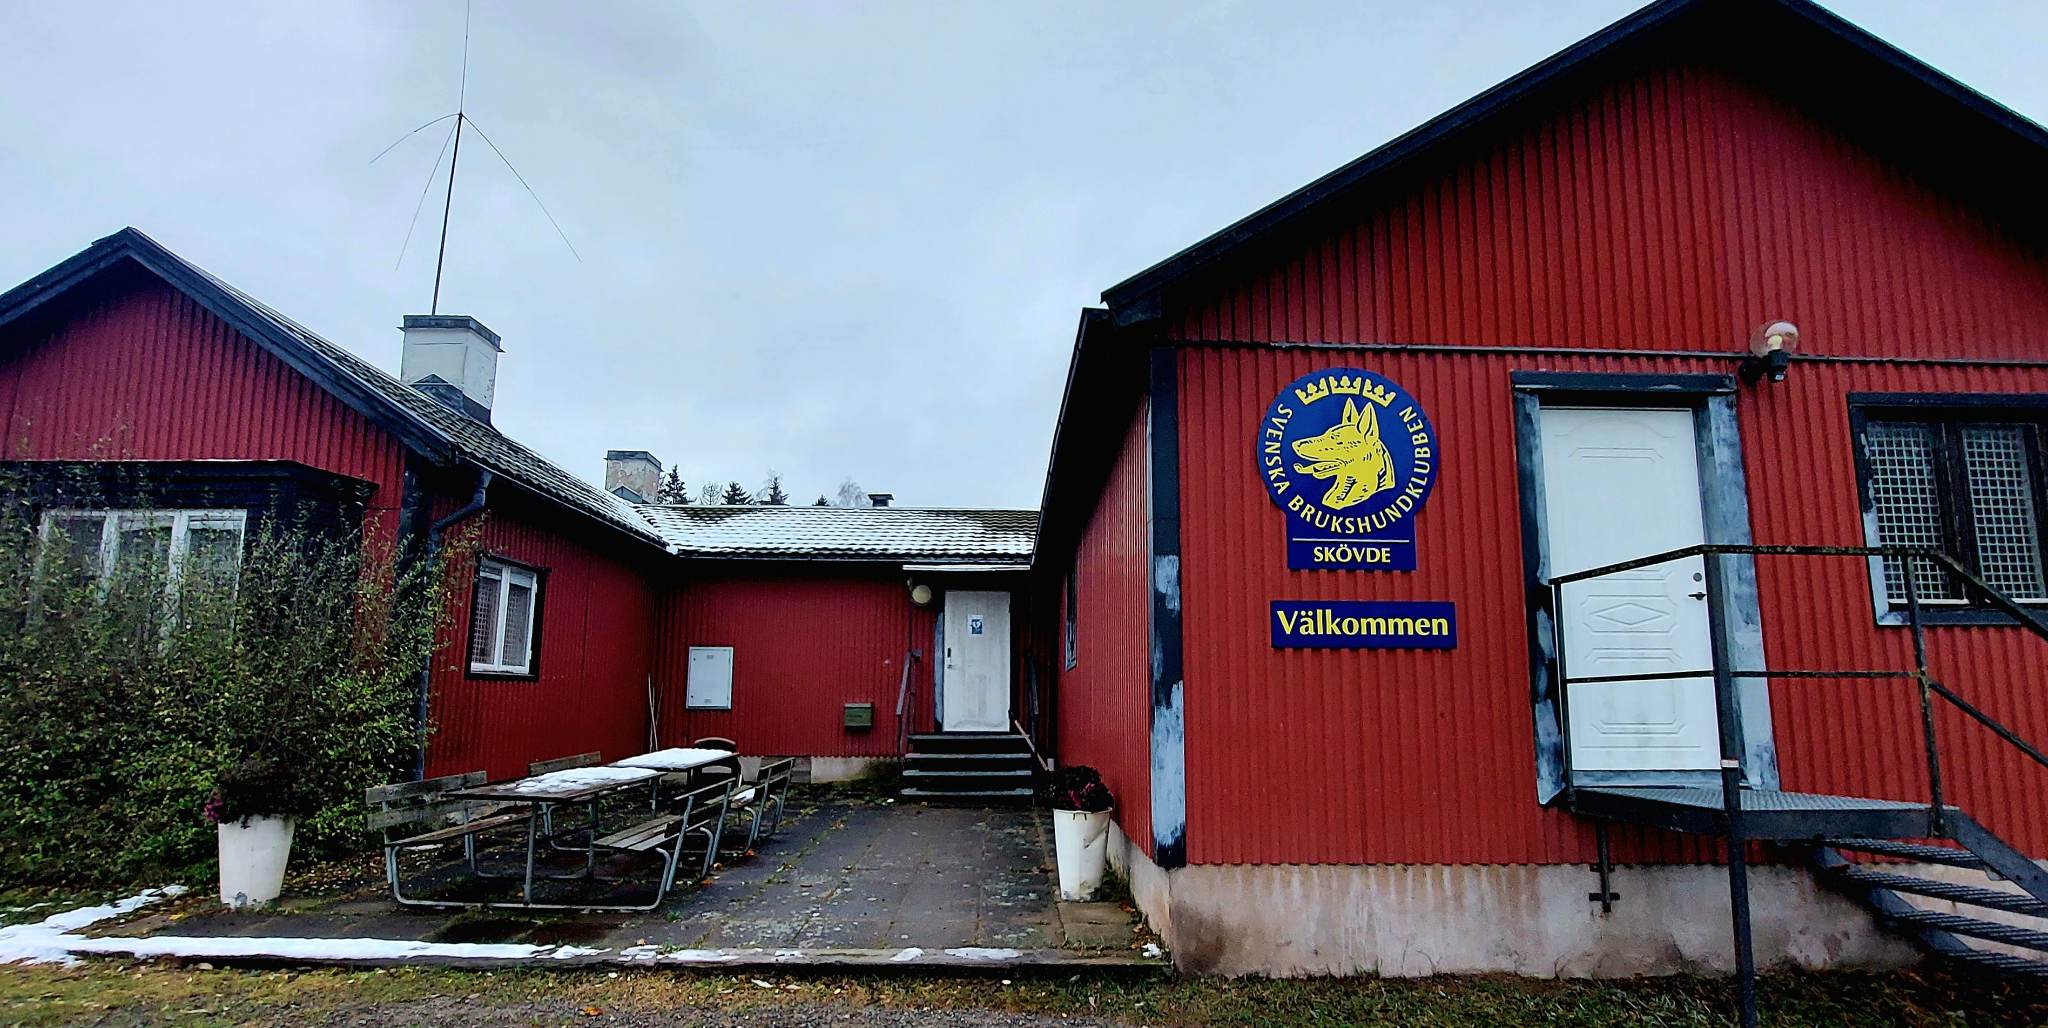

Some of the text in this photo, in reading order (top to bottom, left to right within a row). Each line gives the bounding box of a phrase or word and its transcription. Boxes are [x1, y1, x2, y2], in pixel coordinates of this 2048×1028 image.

[1264, 403, 1432, 534] SVENSKA BRUKSHUNDKLUBBEN
[1313, 544, 1391, 564] SKÖVDE
[1276, 608, 1449, 636] Välkommen
